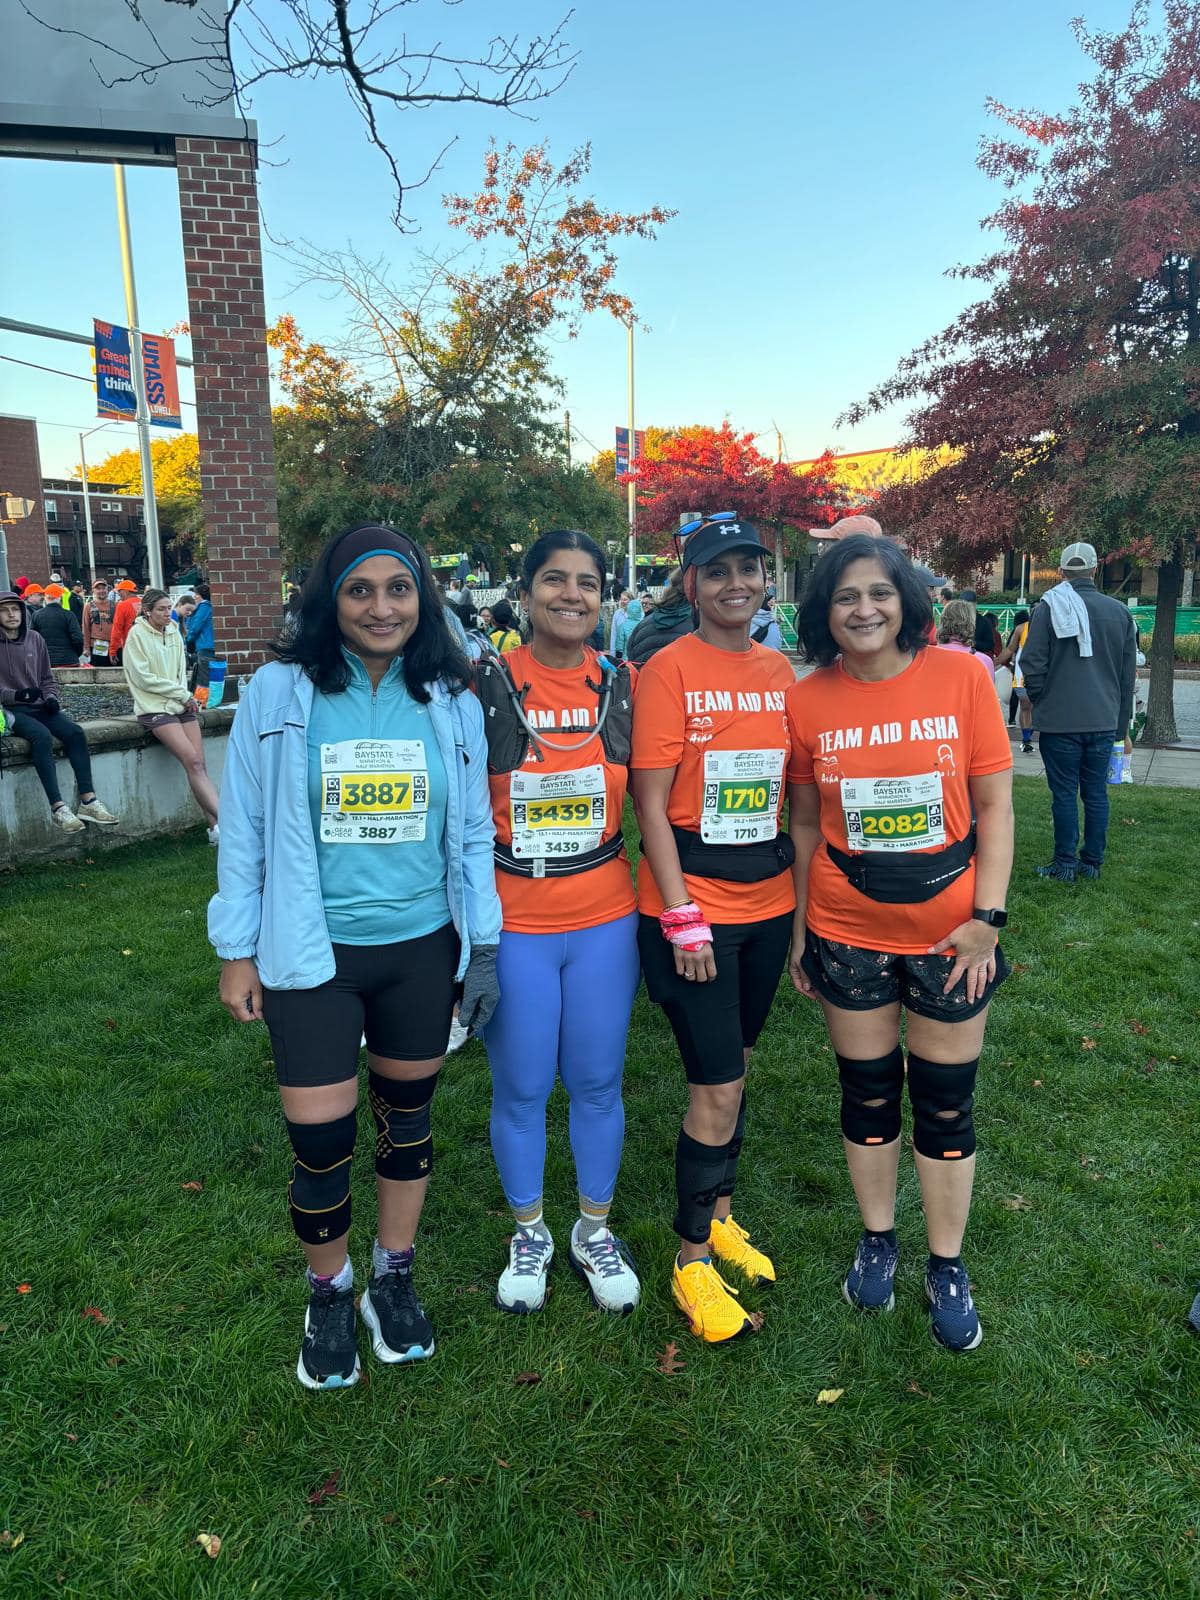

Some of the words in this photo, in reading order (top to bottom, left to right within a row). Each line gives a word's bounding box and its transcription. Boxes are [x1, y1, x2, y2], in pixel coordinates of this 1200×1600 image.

[100, 348, 128, 366] Great
[98, 363, 130, 378] minds
[144, 340, 165, 406] UMASS
[104, 376, 135, 393] think
[684, 690, 733, 714] TEAM
[737, 692, 762, 712] AID
[765, 690, 786, 712] AS
[528, 709, 556, 728] AM
[561, 708, 590, 728] AID
[817, 727, 862, 754] TEAM
[868, 722, 902, 746] AID
[910, 716, 959, 742] ASHA
[540, 780, 576, 789] BAYSTATE
[873, 787, 912, 795] BAYSTATE
[344, 782, 410, 806] 3887
[723, 787, 766, 808] 1710
[529, 804, 589, 823] 3439
[863, 812, 927, 834] 2082
[358, 827, 397, 838] 3887
[734, 828, 758, 839] 1710
[545, 842, 579, 853] 3439
[900, 838, 934, 847] MARATHON
